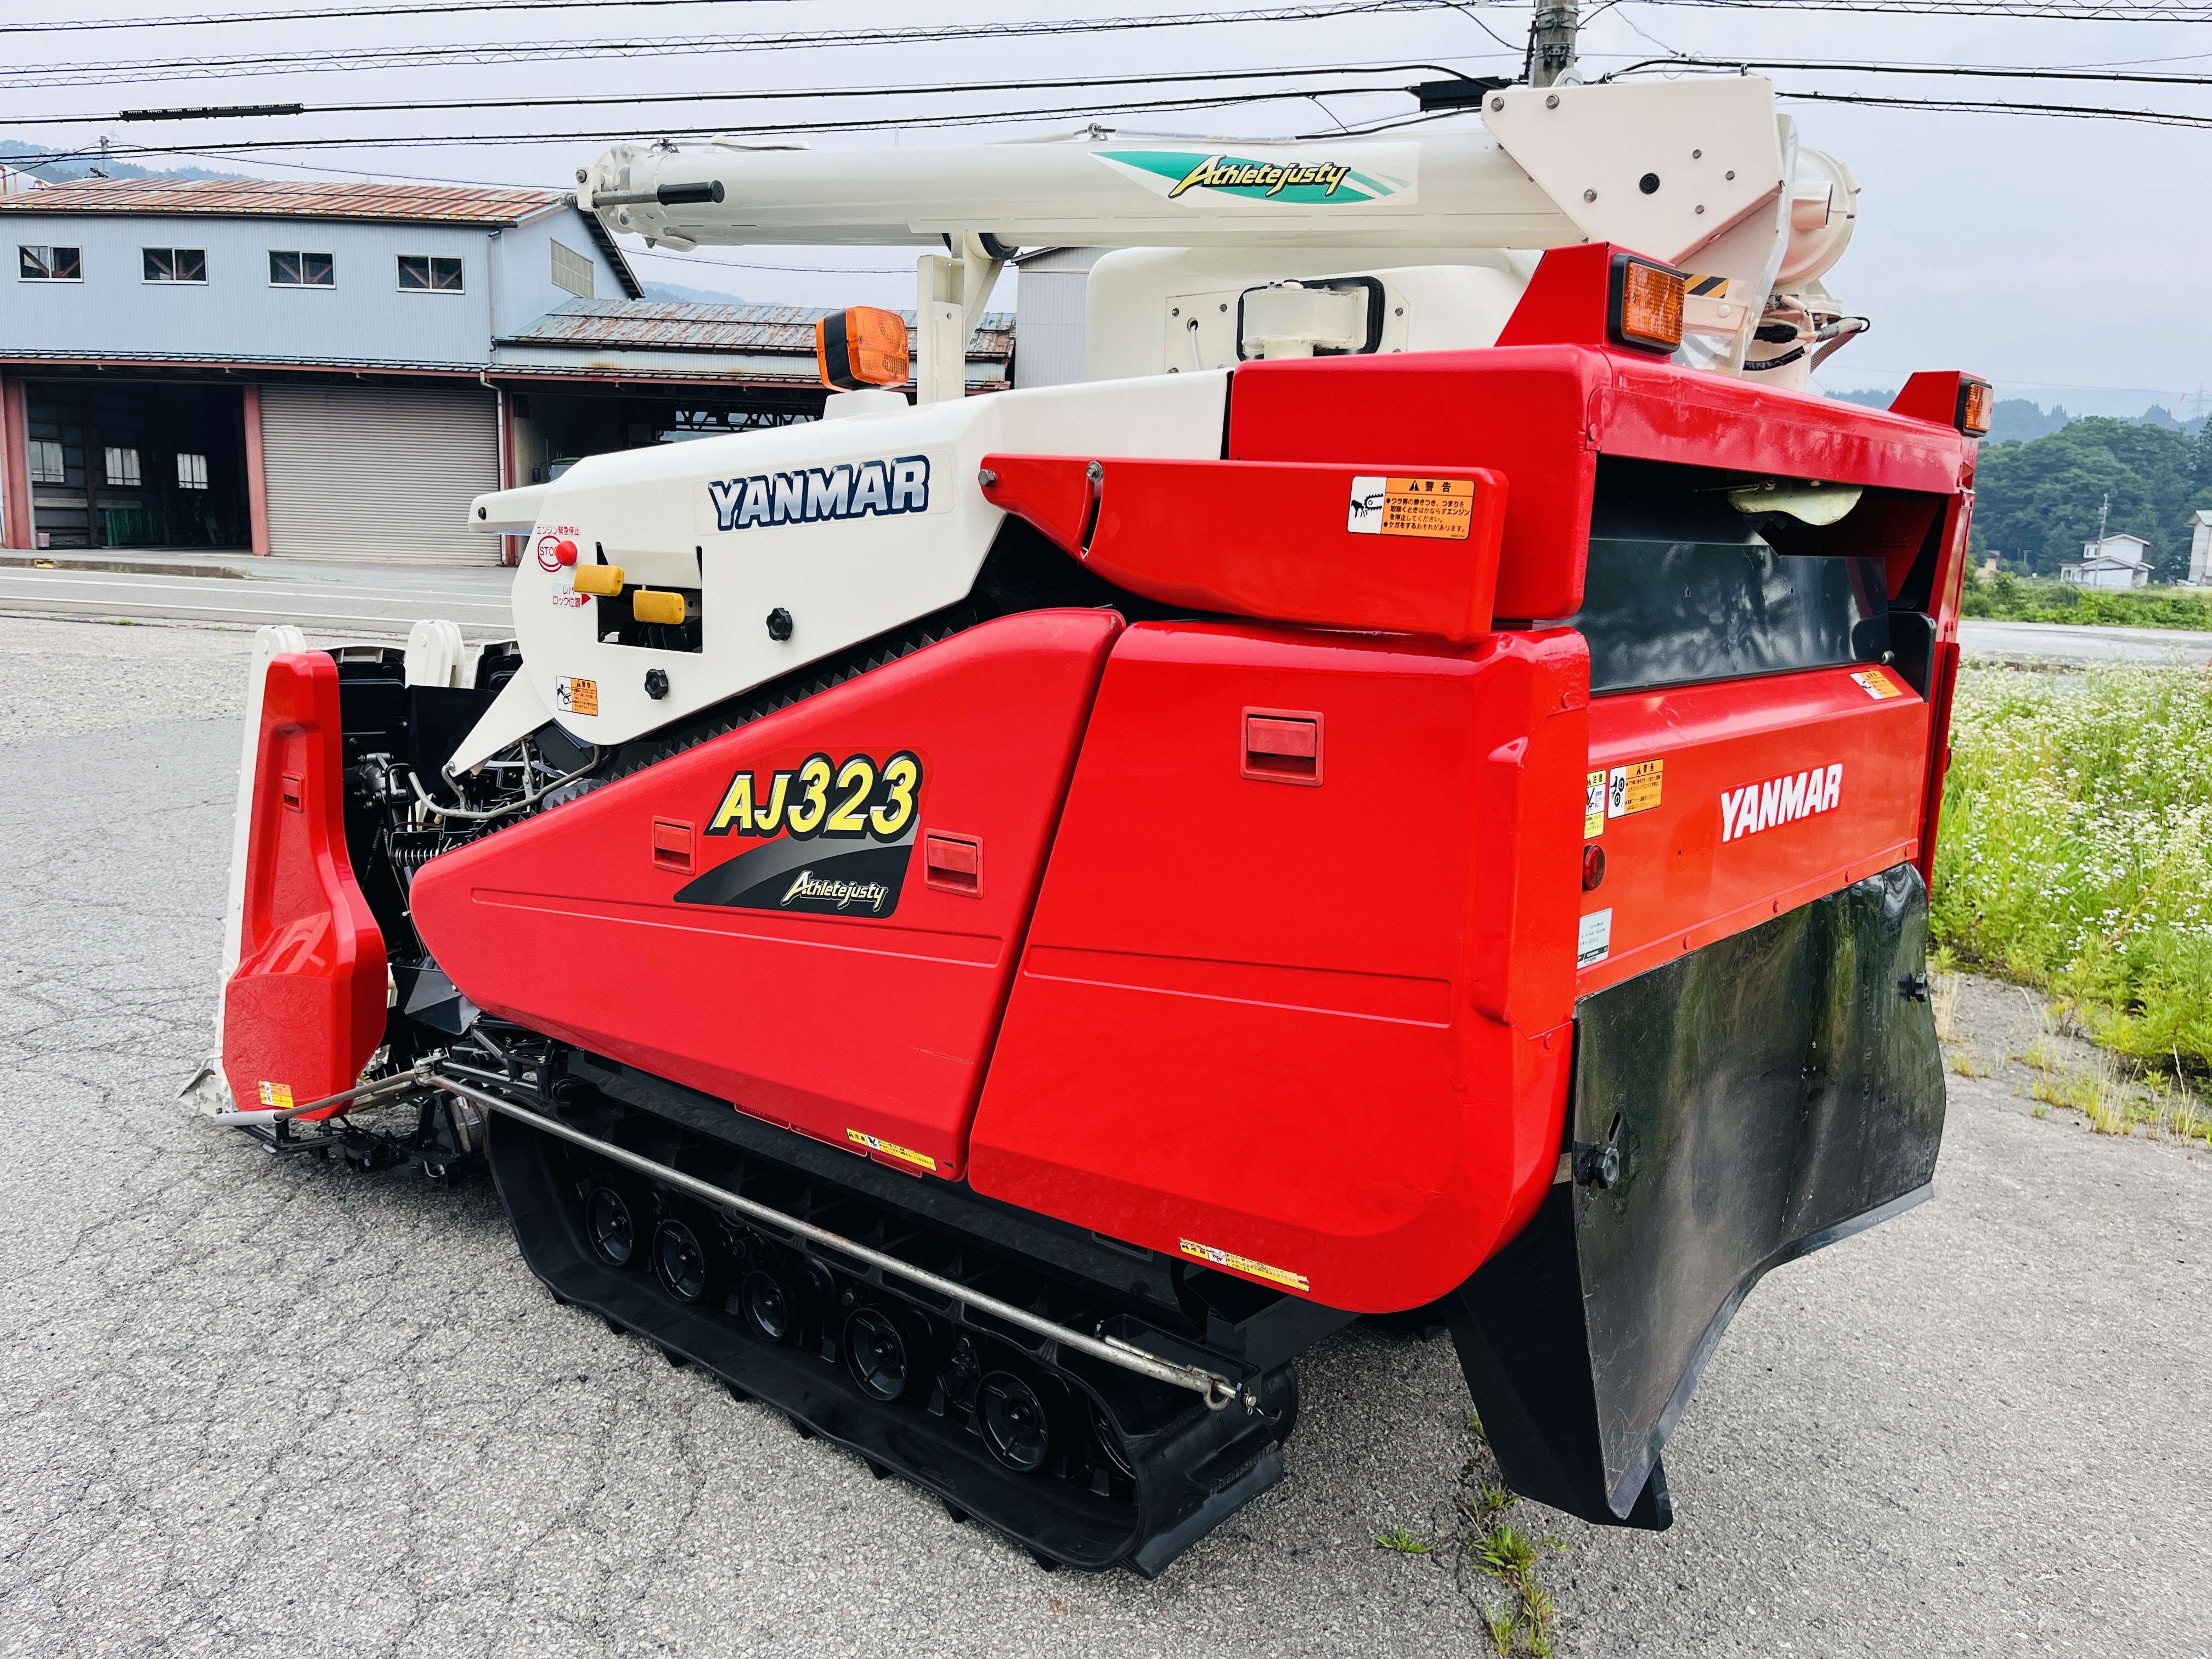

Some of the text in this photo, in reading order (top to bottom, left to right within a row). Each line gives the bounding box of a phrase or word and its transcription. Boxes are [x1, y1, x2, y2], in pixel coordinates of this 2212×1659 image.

[1167, 155, 1351, 199] Athletejusty
[708, 455, 930, 531] YANMAR
[537, 526, 580, 535] エンジン緊急停止
[1389, 522, 1465, 533] ケガをするおそれがあります。
[553, 596, 581, 608] ロック位置
[706, 752, 921, 839] AJ323
[1720, 763, 1842, 842] YANMAR
[780, 870, 889, 911] Athletejusty
